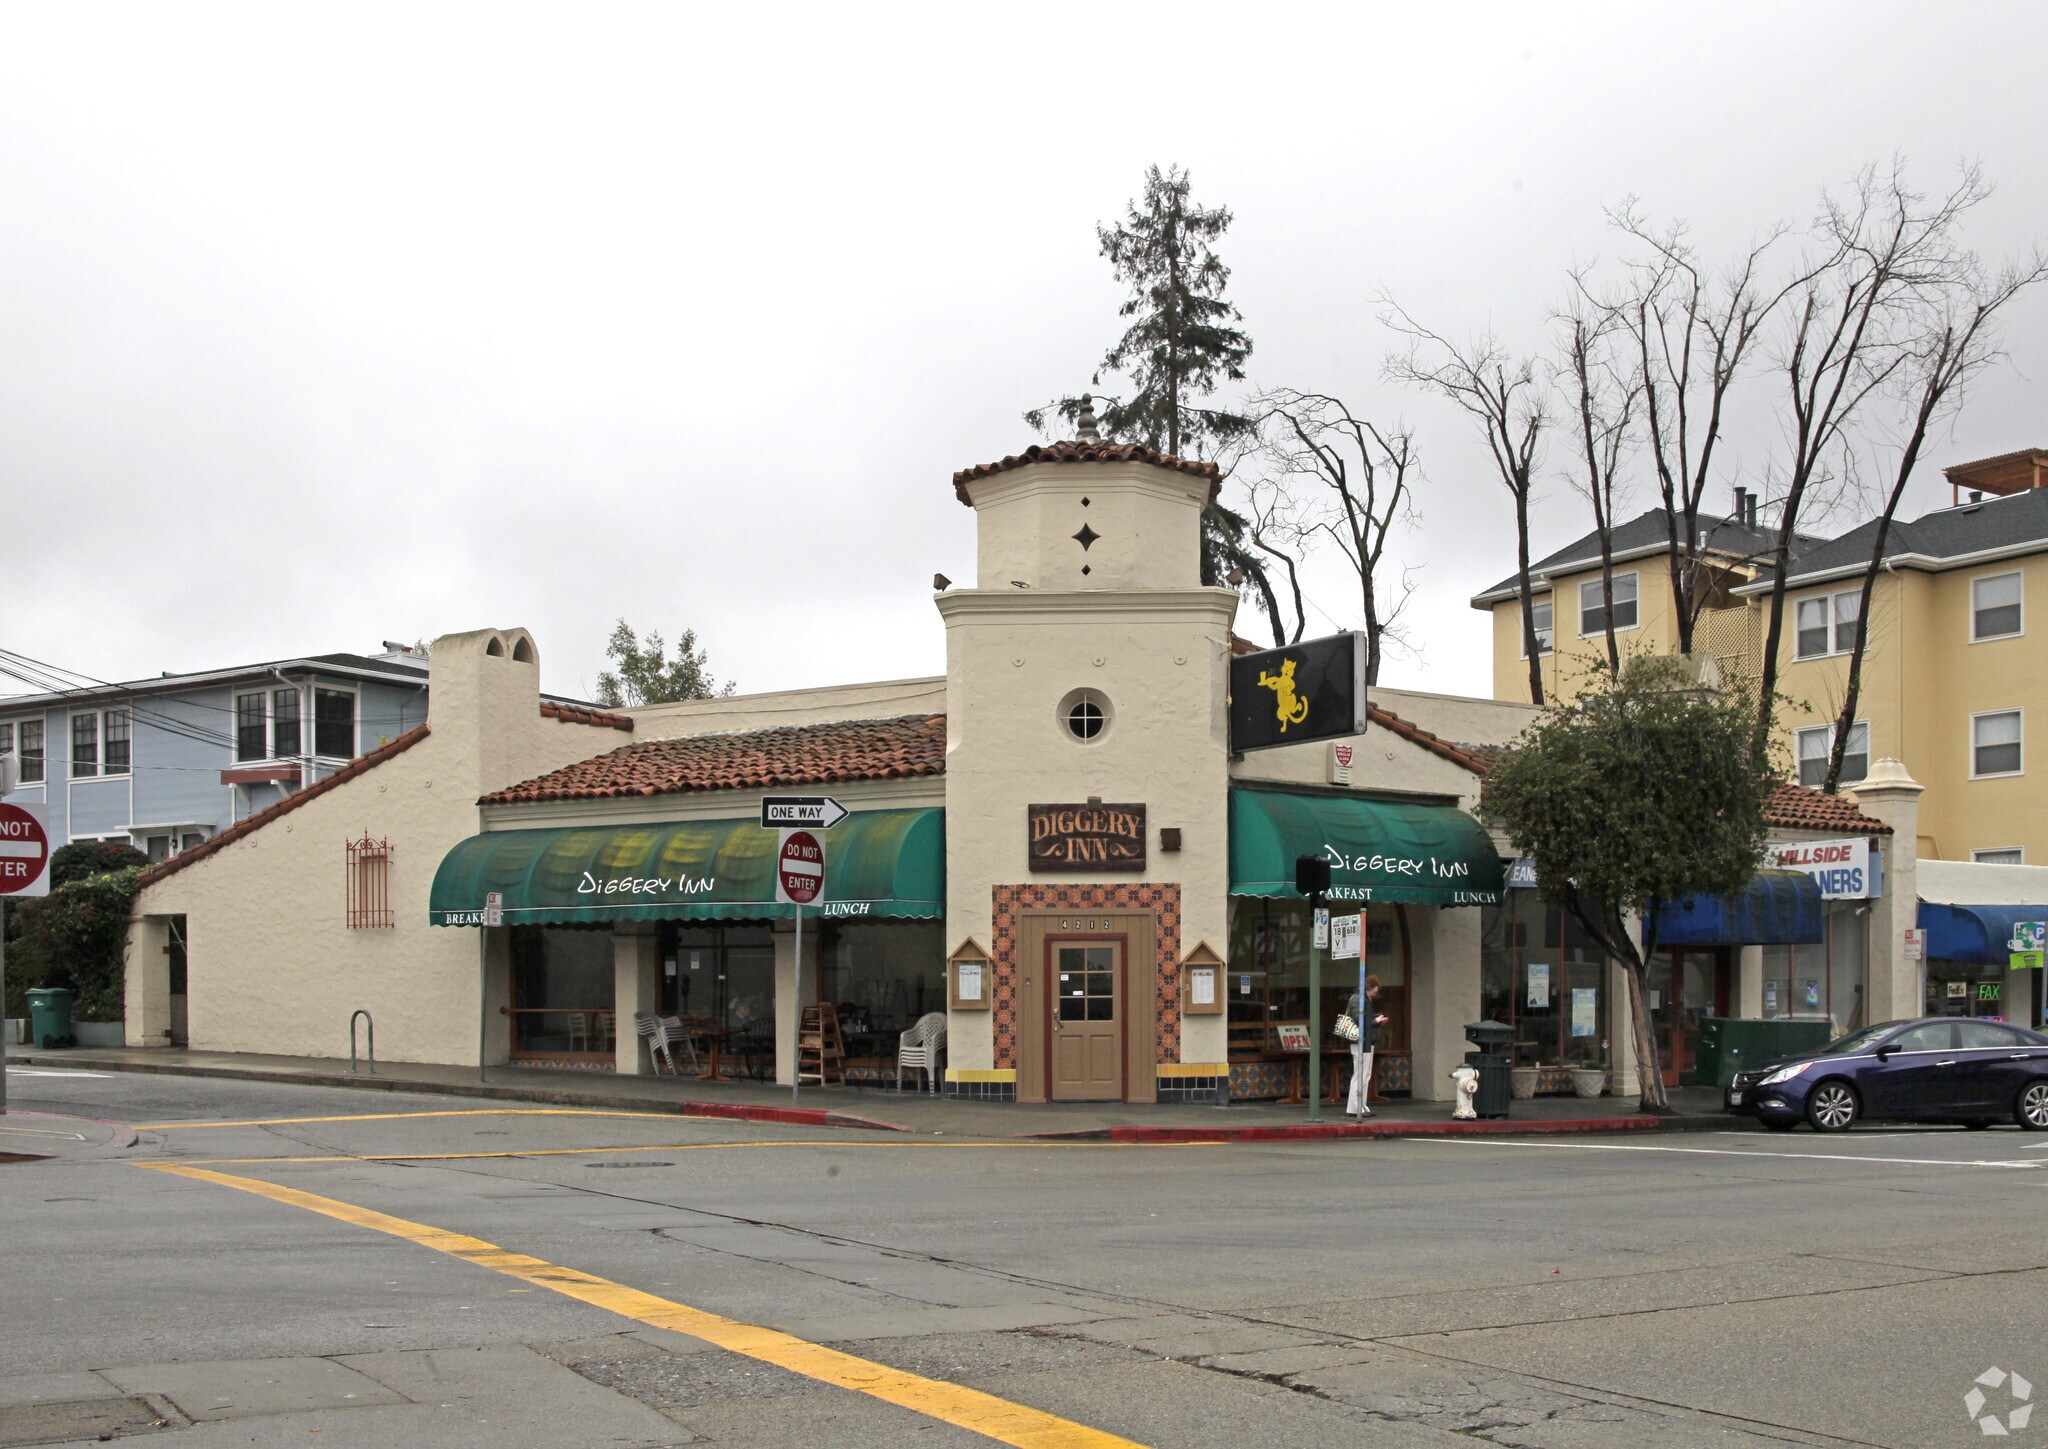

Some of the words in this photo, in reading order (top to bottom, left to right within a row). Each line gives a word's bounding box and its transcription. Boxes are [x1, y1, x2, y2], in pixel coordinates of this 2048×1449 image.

[771, 806, 794, 818] ONE
[798, 806, 822, 819] WAY
[0, 821, 32, 837] NOT
[1032, 809, 1141, 842] DIGGERY
[787, 843, 799, 857] DO
[802, 846, 819, 860] NOT
[1064, 837, 1109, 862] INN
[1776, 845, 1852, 867] HILLSIDE
[1431, 857, 1469, 879] INN
[679, 873, 716, 895] INN
[788, 876, 816, 891] ENTER
[1454, 891, 1496, 904] LUNCH
[824, 902, 870, 916] LUNCH
[1334, 927, 1342, 936] 18
[1346, 926, 1356, 935] 618
[2035, 927, 2045, 939] P
[1335, 939, 1340, 947] V
[1979, 984, 2000, 999] FAX
[1282, 1034, 1310, 1049] OPEN
